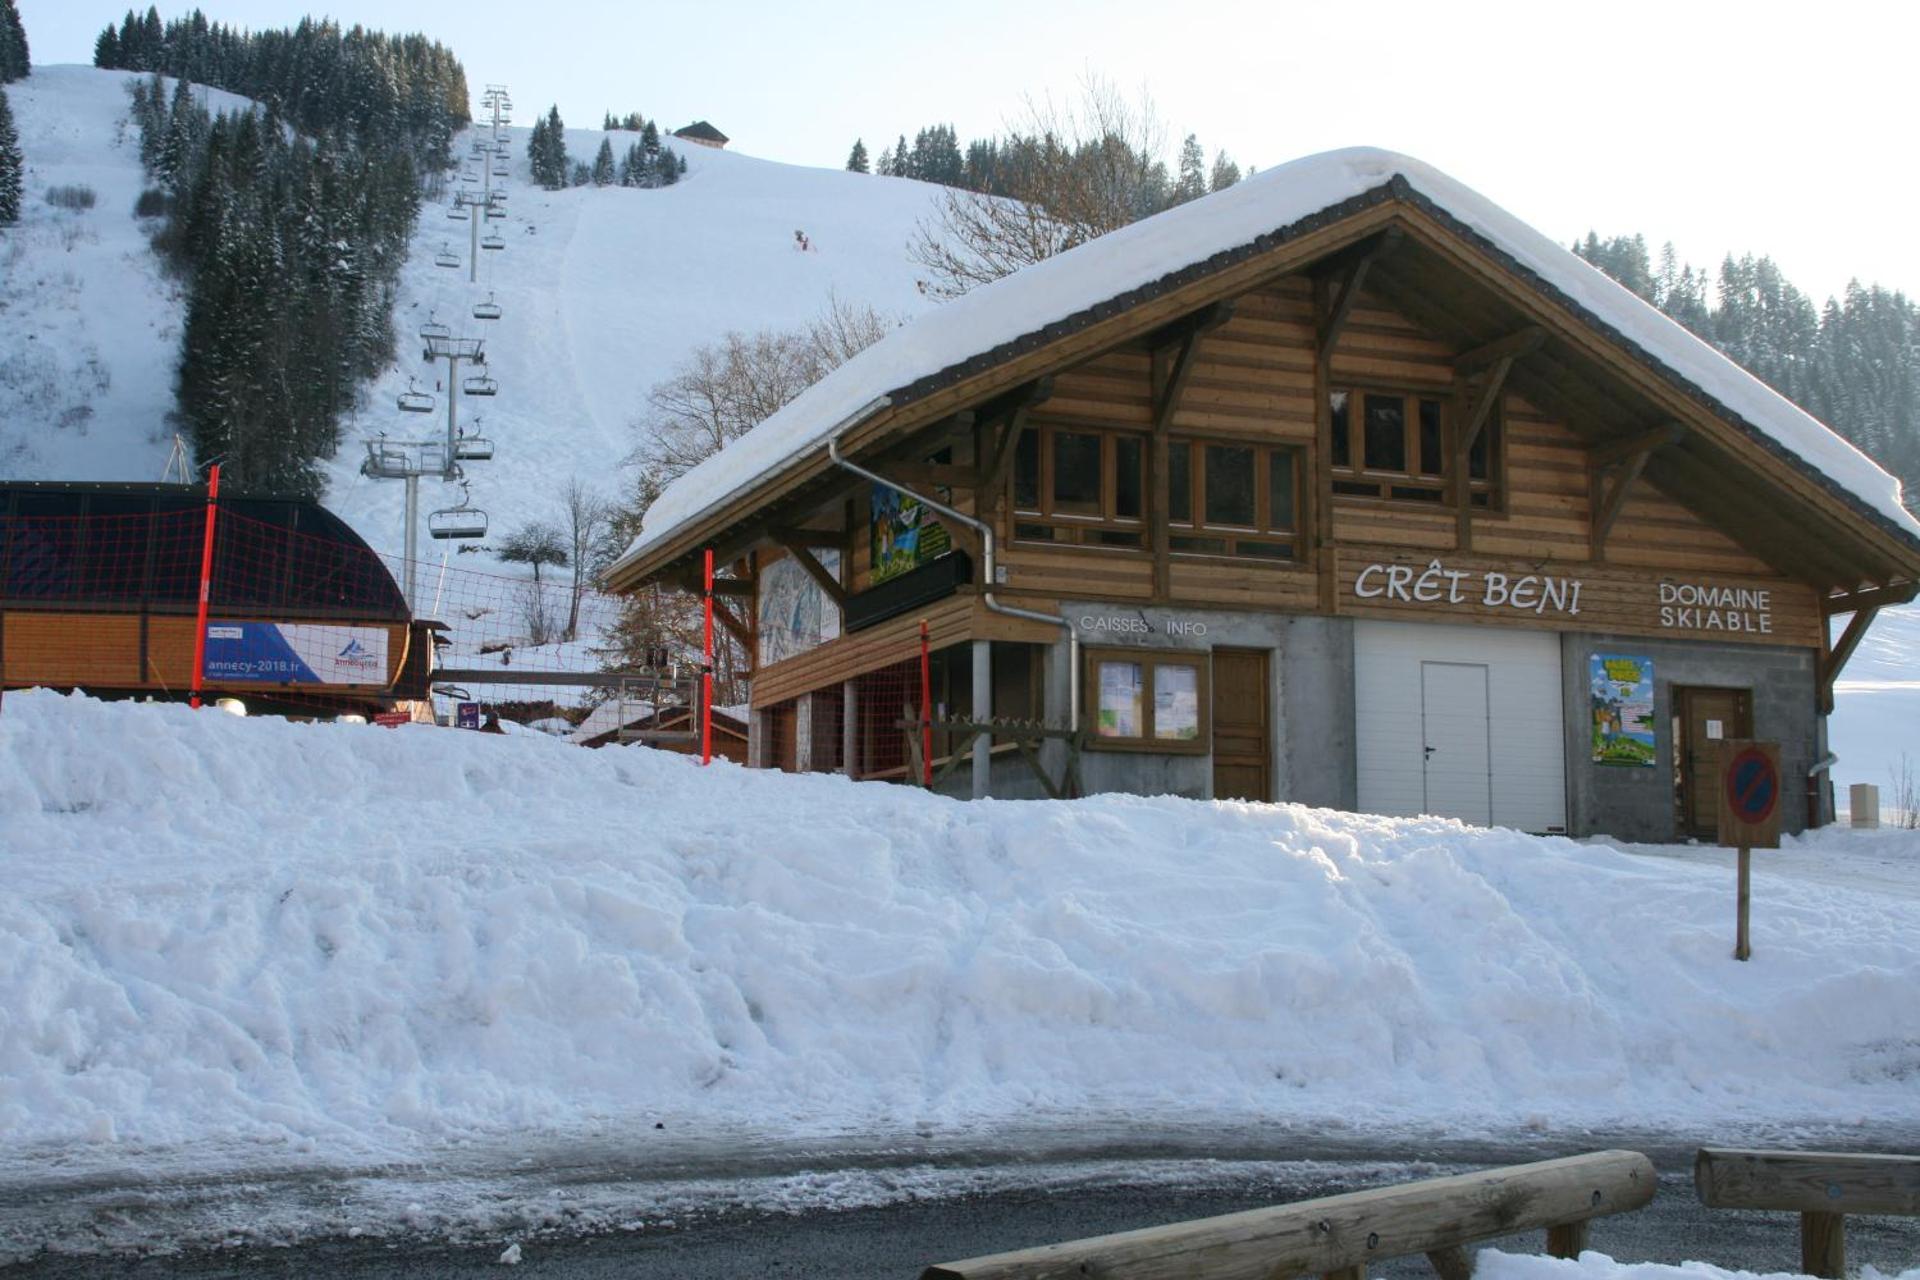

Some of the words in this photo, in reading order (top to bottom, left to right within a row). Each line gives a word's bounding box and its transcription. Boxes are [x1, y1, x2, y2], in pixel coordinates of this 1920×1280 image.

[1354, 558, 1471, 604] CRÊT
[1659, 583, 1771, 610] DOMAINE
[1080, 615, 1149, 633] CAISSES
[1166, 620, 1207, 636] INFO
[1660, 606, 1773, 633] SKIABLE
